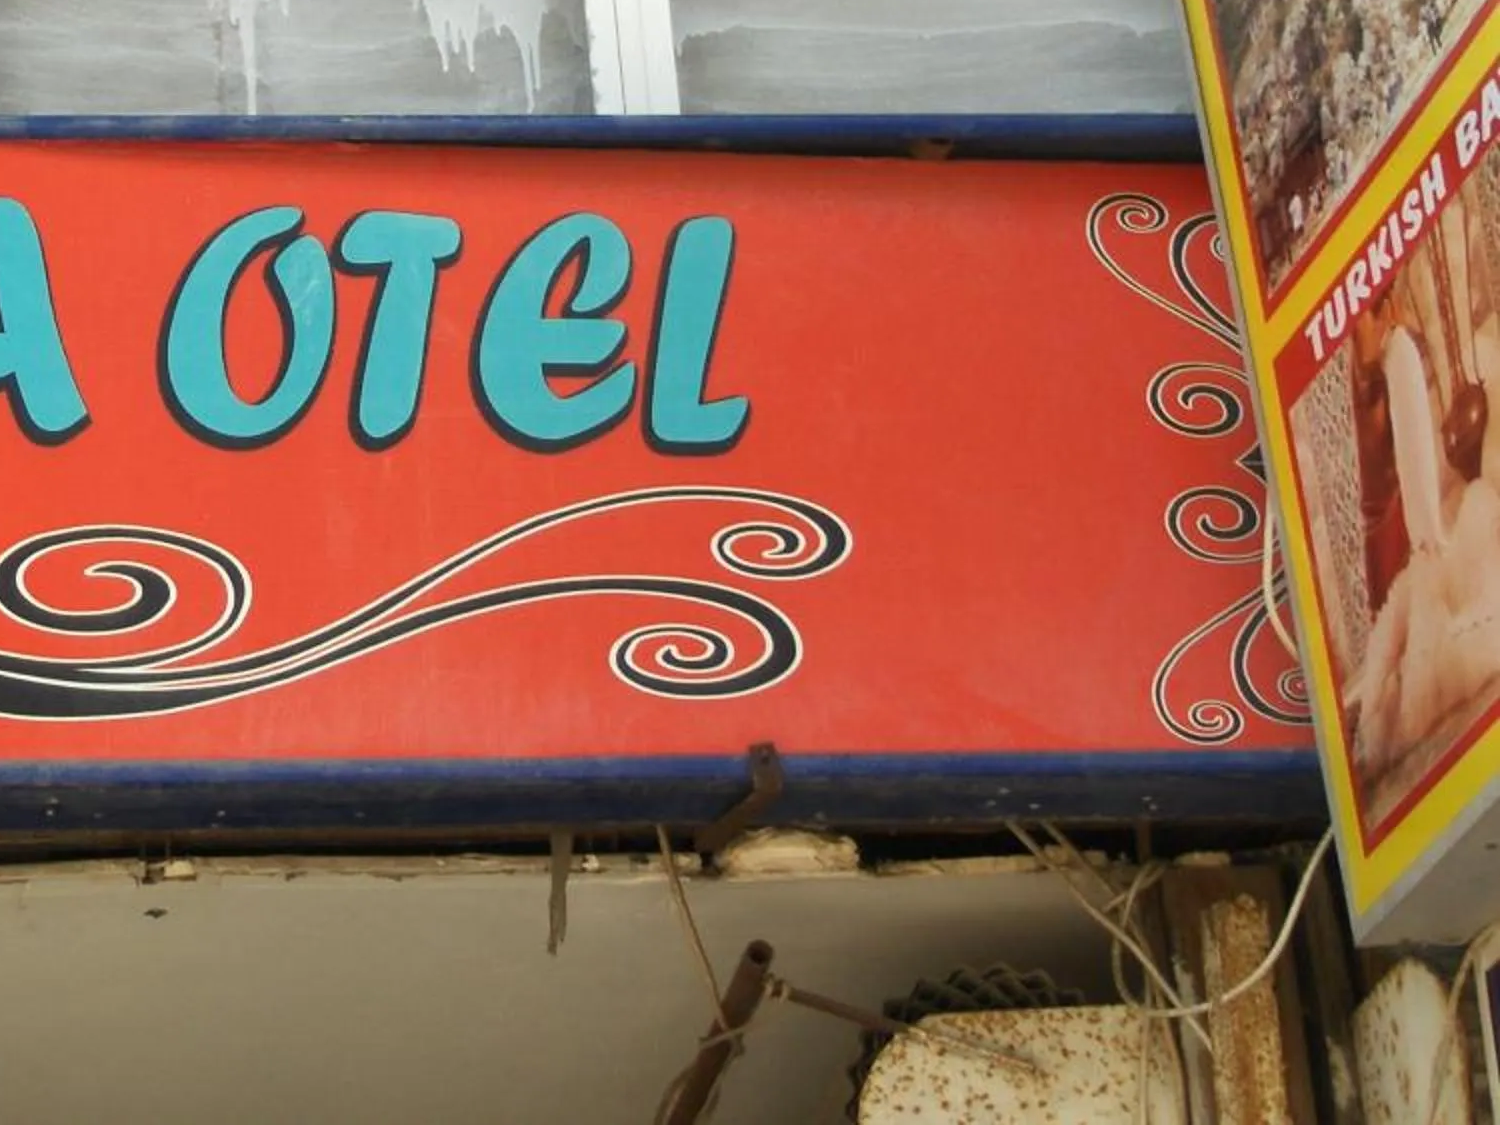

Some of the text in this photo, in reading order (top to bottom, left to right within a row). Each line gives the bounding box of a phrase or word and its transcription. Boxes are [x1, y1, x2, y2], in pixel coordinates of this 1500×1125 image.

[156, 205, 752, 457] OTEL
[1304, 66, 1500, 362] TURKISH BA
